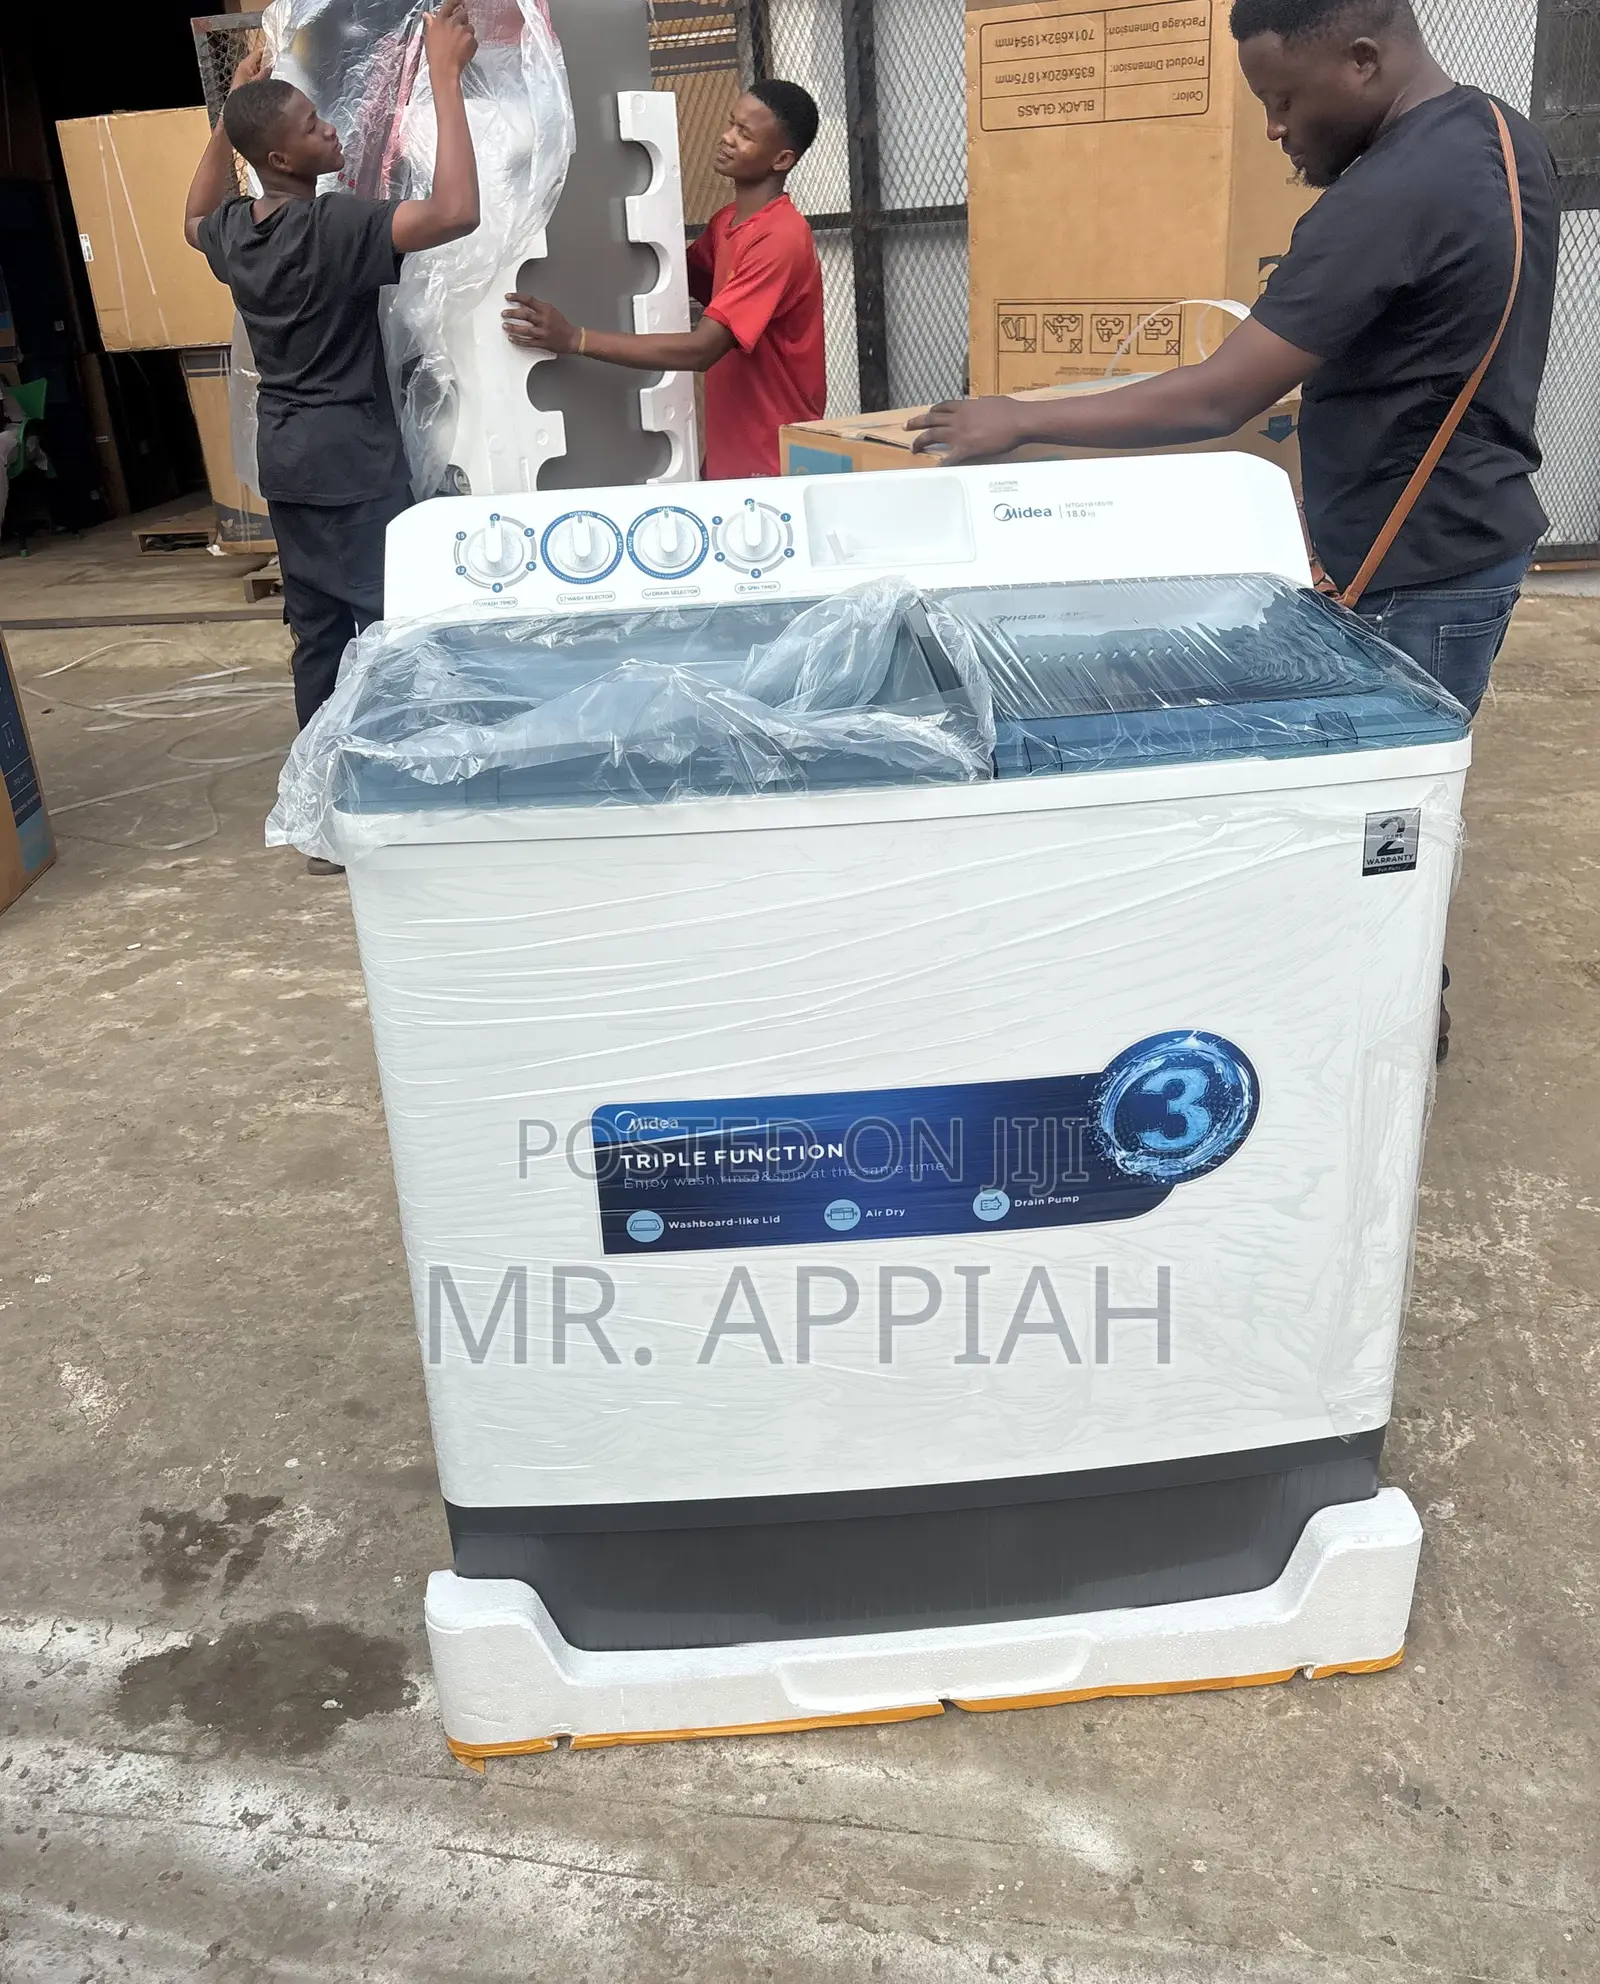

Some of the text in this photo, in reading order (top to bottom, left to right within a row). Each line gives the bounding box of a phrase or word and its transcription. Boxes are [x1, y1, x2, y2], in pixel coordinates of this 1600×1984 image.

[1106, 17, 1207, 36] Package Dimension:
[1109, 55, 1206, 73] Product Dimension:
[995, 66, 1095, 84] 635x620x1875mm
[1172, 90, 1204, 102] Color:
[1017, 100, 1095, 118] BLACK GLASS
[993, 503, 1053, 522] Midea
[1066, 509, 1087, 519] 18.0
[585, 593, 613, 601] SELECTOR
[651, 588, 699, 597] DRAIN SELECTOR
[1377, 816, 1406, 857] 2
[1366, 853, 1414, 866] WARRANTY
[1135, 1067, 1213, 1150] 3
[614, 1110, 679, 1134] Midea
[620, 1142, 844, 1170] TRIPLE FUNCTION
[624, 1177, 669, 1191] Enjoy
[811, 1168, 826, 1179] at
[831, 1165, 857, 1178] the
[862, 1164, 904, 1176] same
[1014, 1193, 1080, 1208] Drain Pump
[865, 1207, 906, 1218] Air Dry
[668, 1214, 781, 1230] Washboard-like Lid
